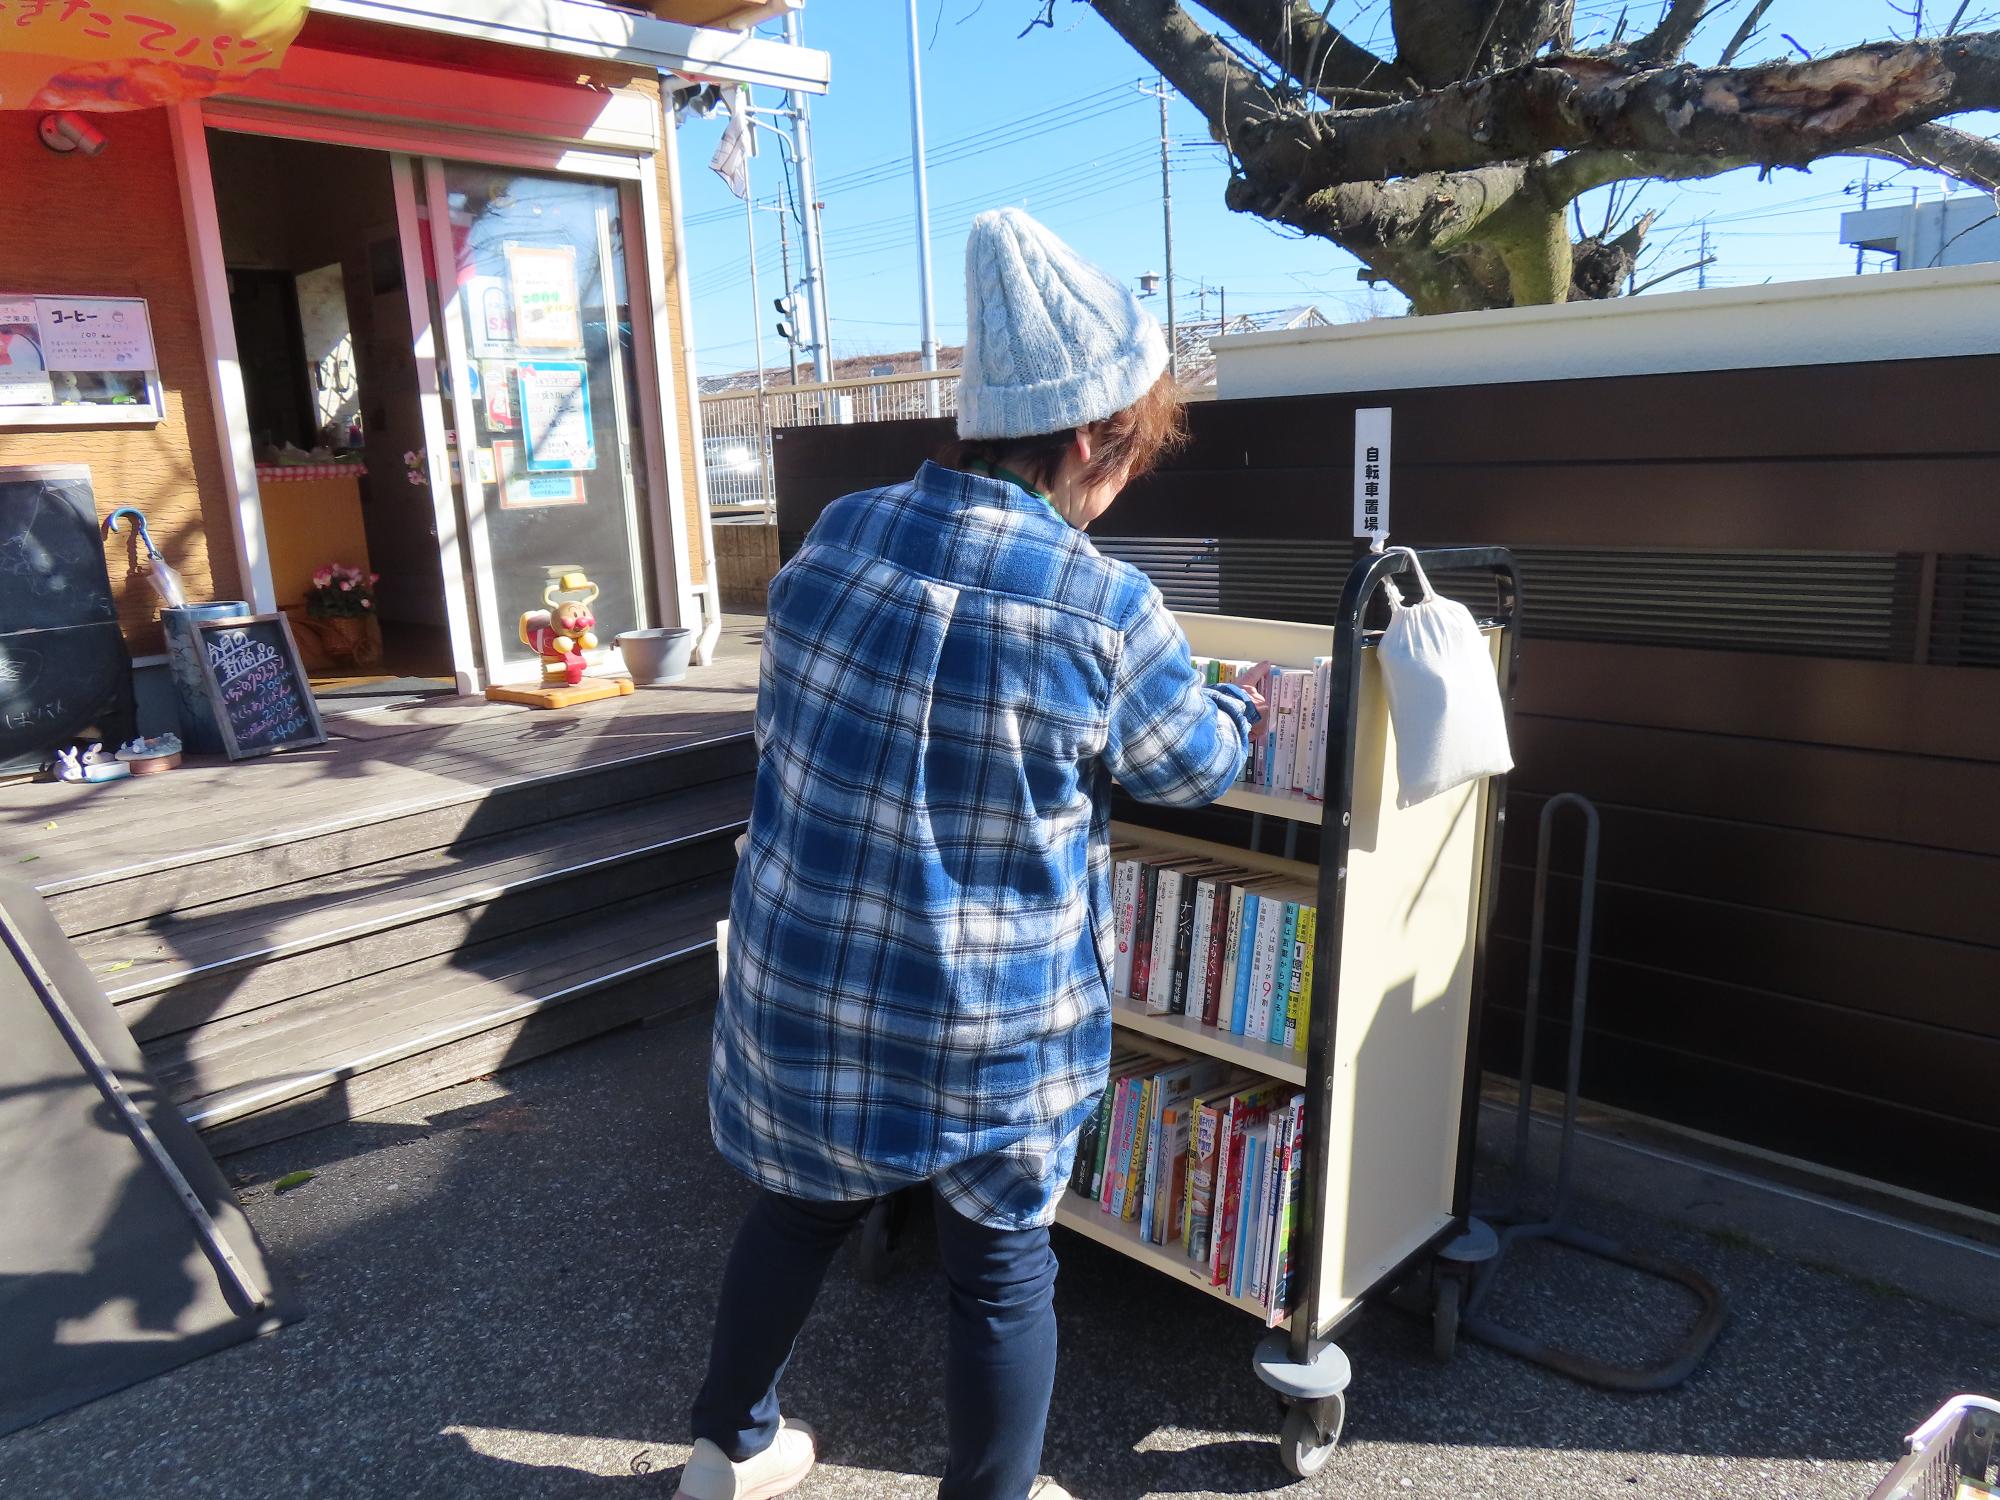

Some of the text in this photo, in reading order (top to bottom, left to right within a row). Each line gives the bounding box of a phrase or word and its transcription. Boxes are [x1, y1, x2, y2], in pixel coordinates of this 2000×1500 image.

[0, 0, 272, 66] きたてパン
[51, 310, 98, 324] コーヒー
[1364, 447, 1379, 531] 自転車置場
[223, 643, 275, 679] 新商品
[1180, 901, 1192, 950] ナンバー
